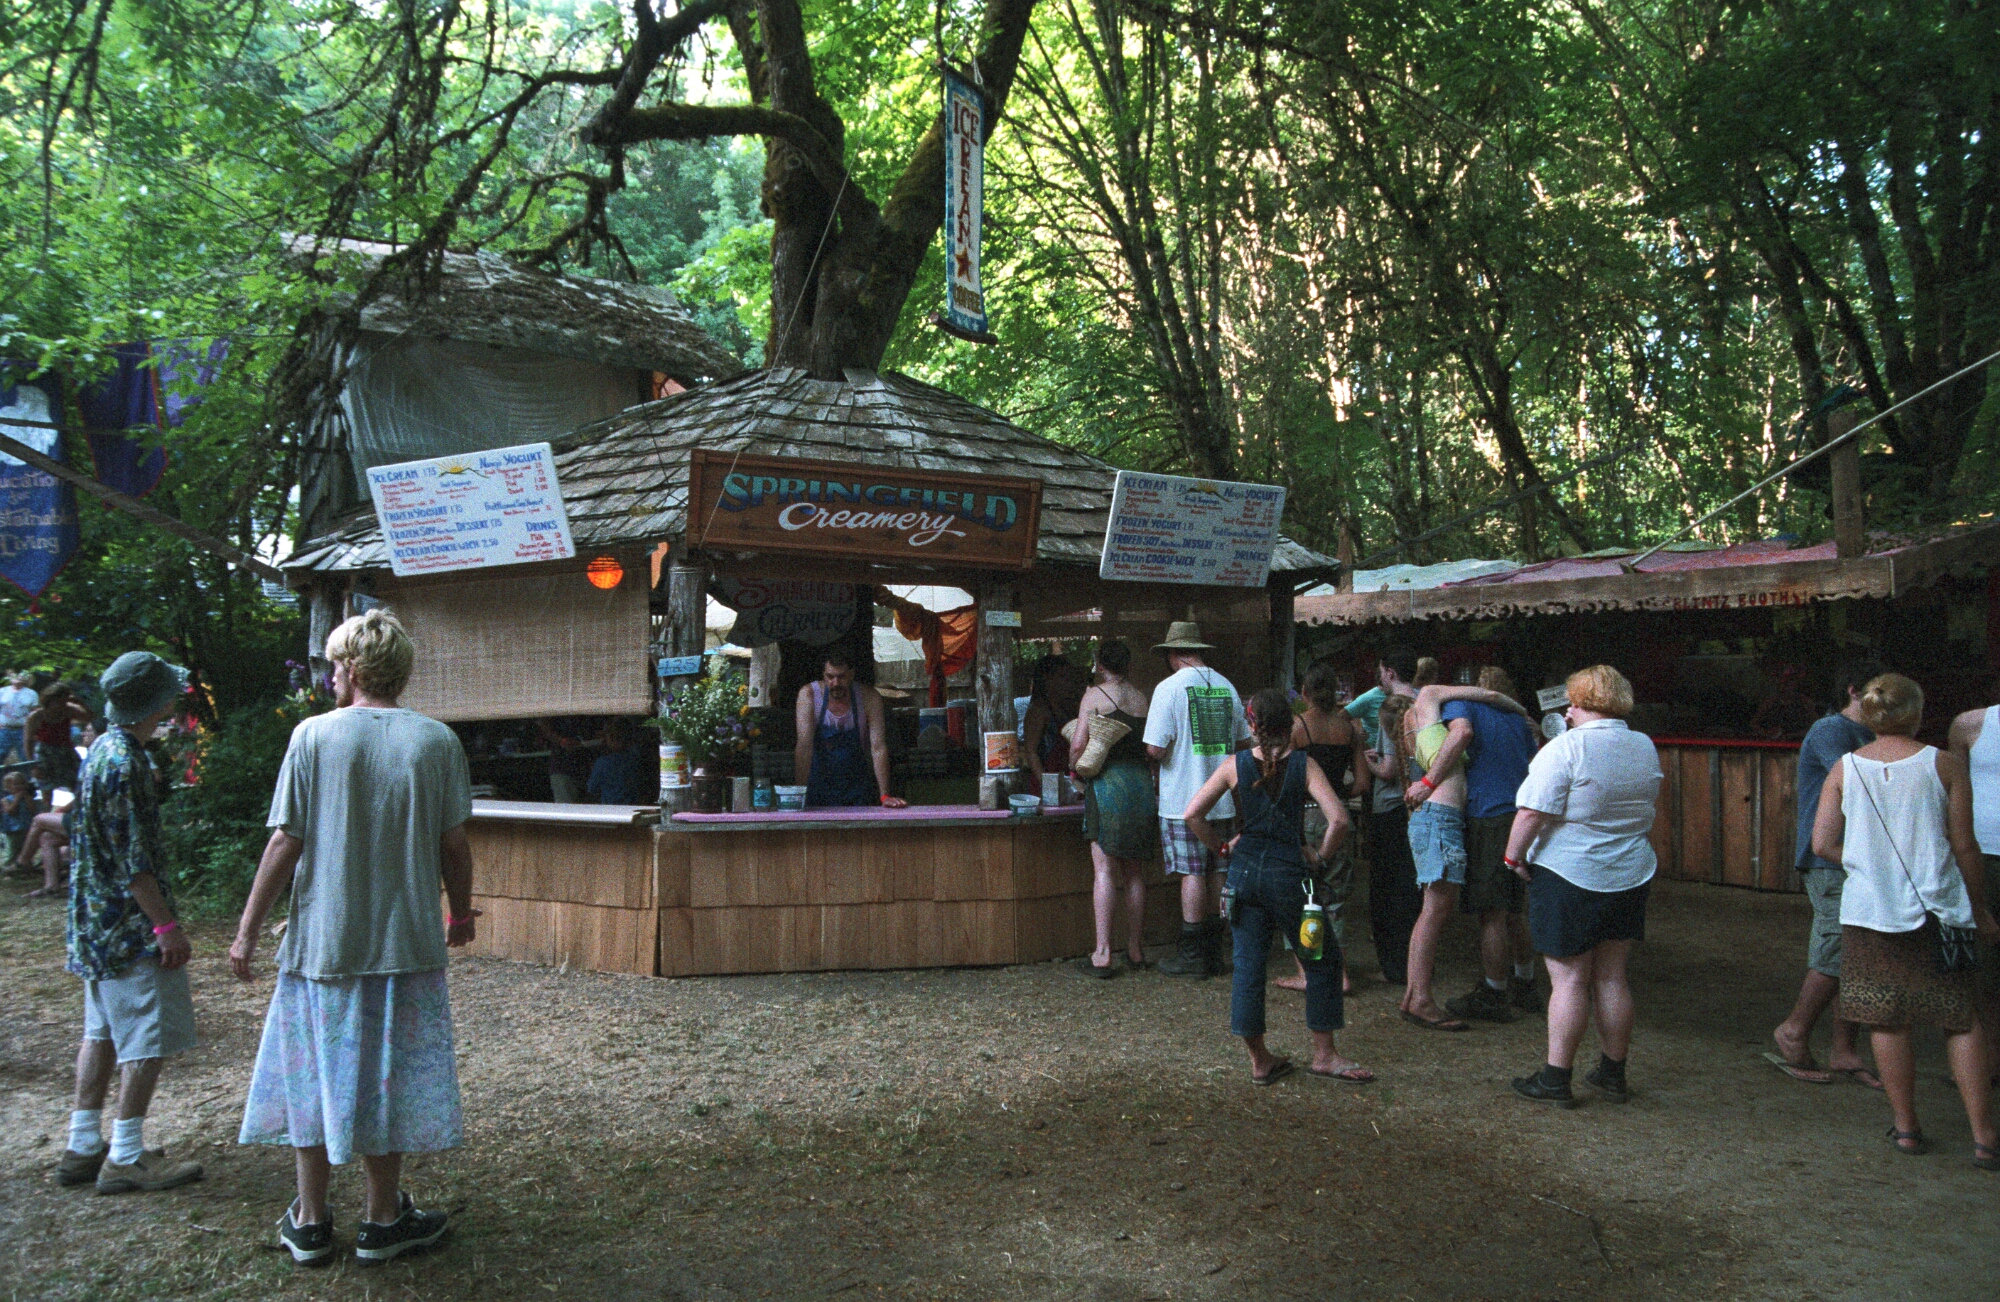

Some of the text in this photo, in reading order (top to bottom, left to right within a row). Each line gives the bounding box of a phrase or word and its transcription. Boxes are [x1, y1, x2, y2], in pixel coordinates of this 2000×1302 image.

[954, 101, 978, 146] ICE
[502, 450, 542, 464] YOGURT
[372, 472, 385, 483] ICE
[386, 469, 417, 481] CREAM
[1123, 477, 1135, 488] ICE
[1137, 478, 1167, 490] CREAM
[1244, 488, 1279, 501] YOGURT
[719, 472, 1018, 532] SPRINGFIELD
[383, 510, 413, 521] FROZEN
[412, 505, 447, 517] YOGURT
[388, 528, 419, 539] FROZEN
[418, 524, 436, 535] SOY
[455, 519, 488, 531] DESSERT
[525, 519, 557, 531] DRINKS
[778, 503, 966, 547] Creamery
[1115, 515, 1148, 526] FROZEN
[1150, 518, 1182, 529] YOGURT
[1112, 533, 1143, 544] FROZEN
[1142, 535, 1160, 545] SOY
[1181, 538, 1213, 549] DESSERT
[404, 545, 430, 556] CREAM
[1108, 551, 1121, 562] ICE
[1121, 552, 1145, 563] CREAM
[1233, 549, 1269, 561] DRINKS
